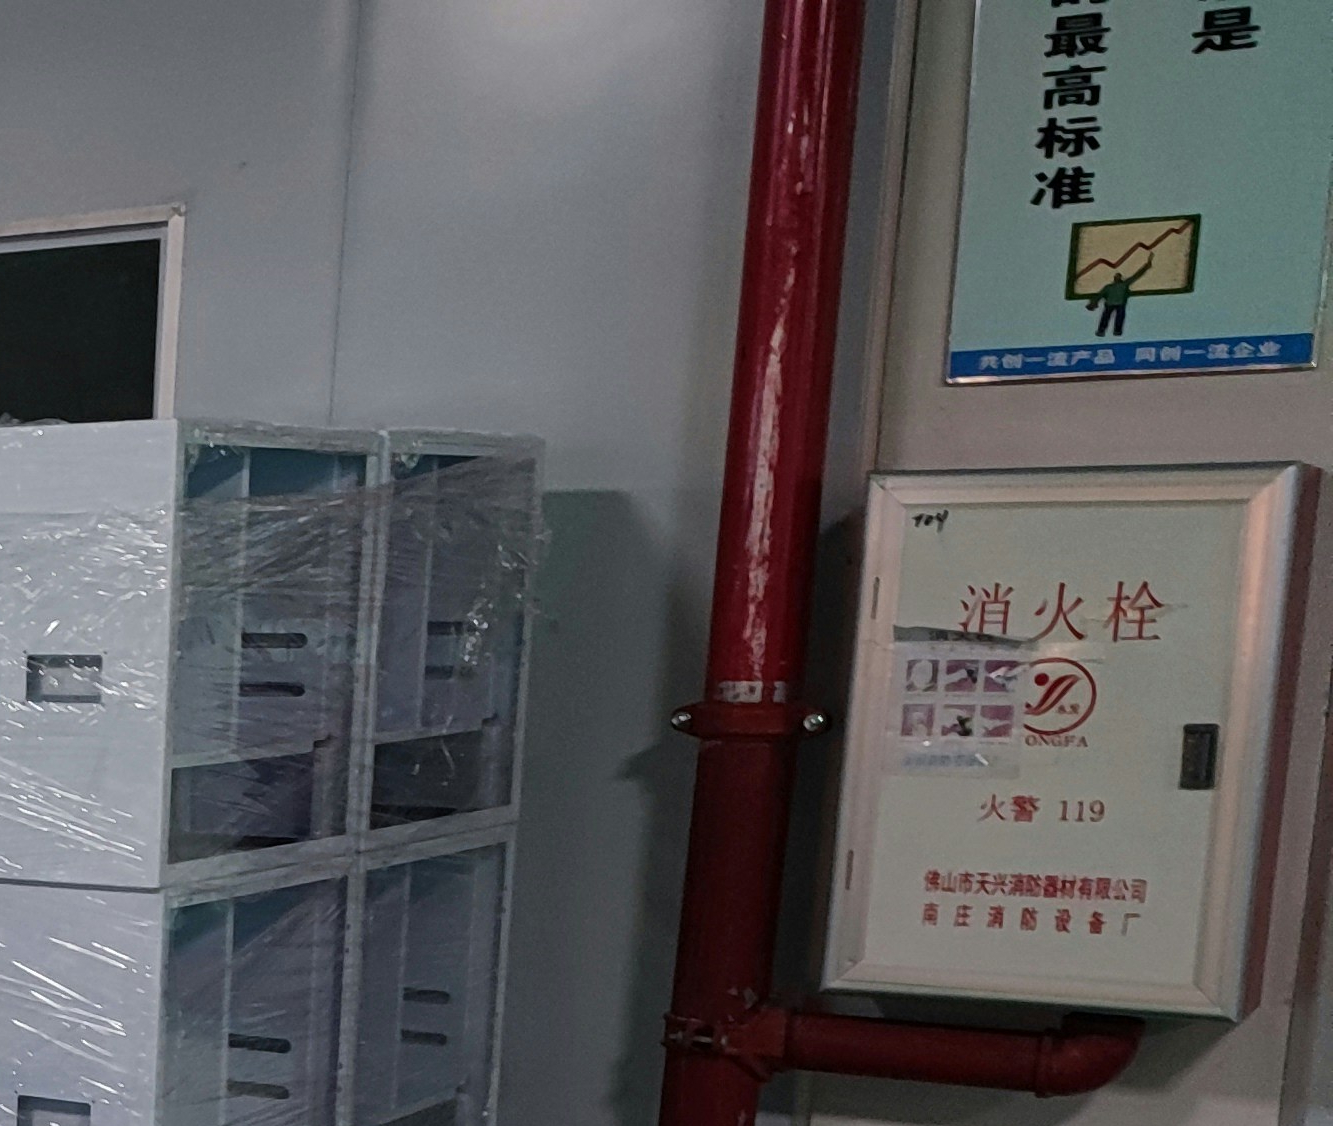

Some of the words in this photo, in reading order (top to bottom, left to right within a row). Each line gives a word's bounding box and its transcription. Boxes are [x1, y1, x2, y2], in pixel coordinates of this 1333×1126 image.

[1030, 0, 1111, 209] 最高标准
[980, 349, 1116, 370] 共创一流产品
[1135, 340, 1282, 363] 同创一流企业
[959, 580, 1165, 643] 消火栓
[977, 793, 1040, 823] 火警
[1059, 799, 1106, 823] 119
